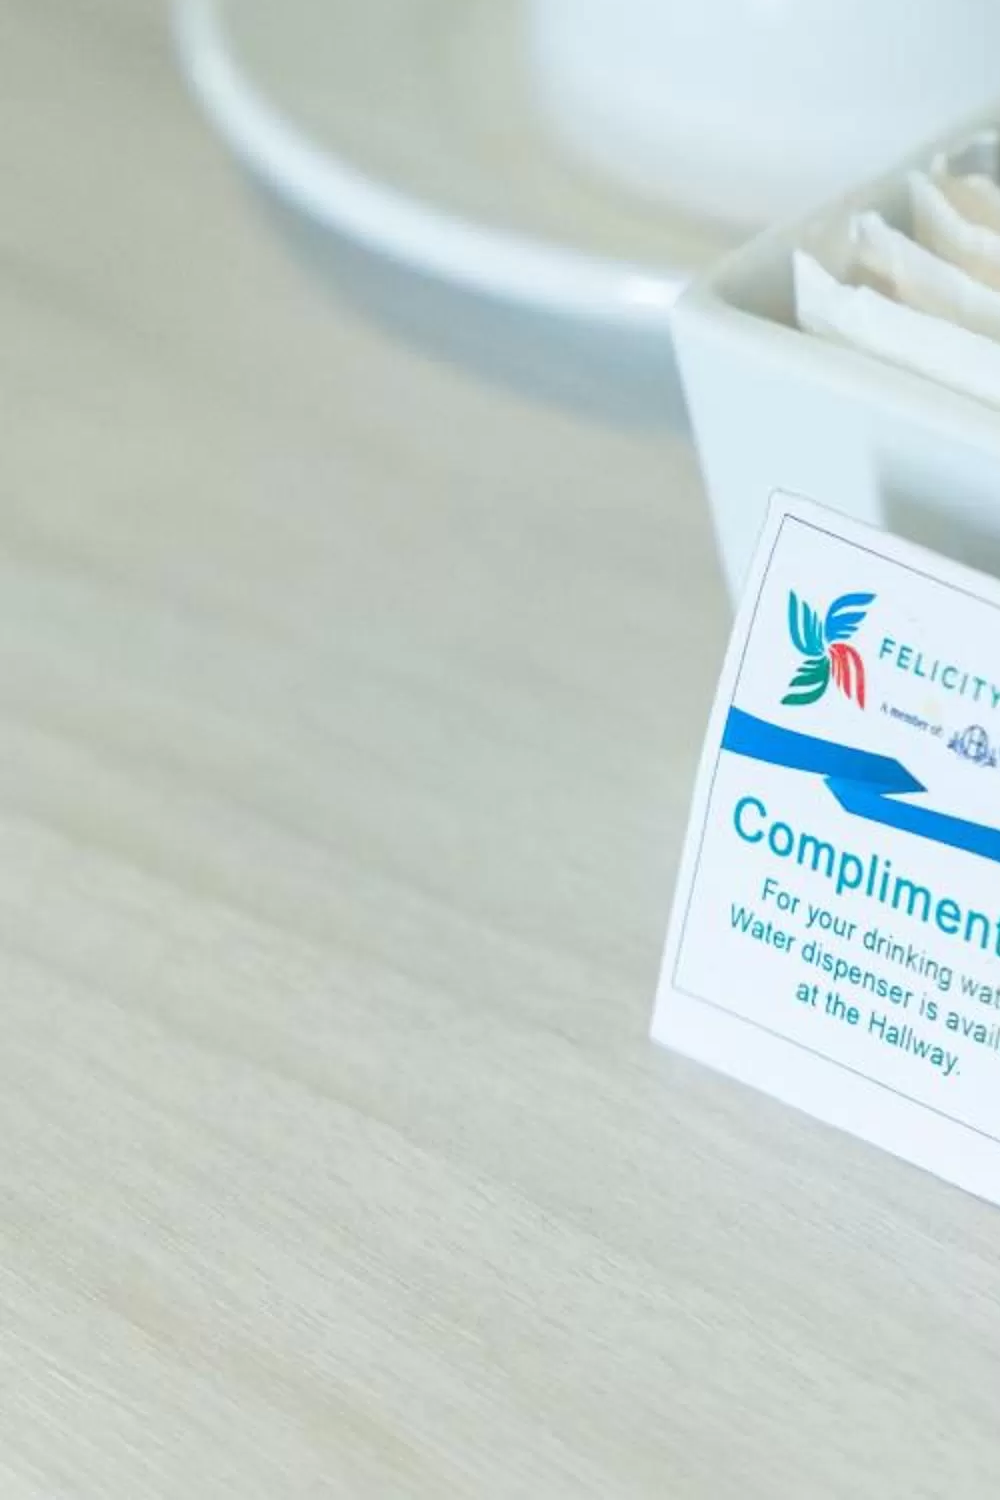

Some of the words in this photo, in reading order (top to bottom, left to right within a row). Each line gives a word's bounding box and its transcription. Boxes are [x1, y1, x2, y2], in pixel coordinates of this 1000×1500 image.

[730, 903, 796, 953] Water
[801, 940, 914, 1009] dispenser
[919, 991, 938, 1021] is
[761, 877, 800, 915] For
[805, 904, 858, 941] your
[863, 928, 953, 992] drinking
[795, 982, 819, 1008] at
[825, 991, 860, 1026] the
[867, 1011, 961, 1077] Hallway.
